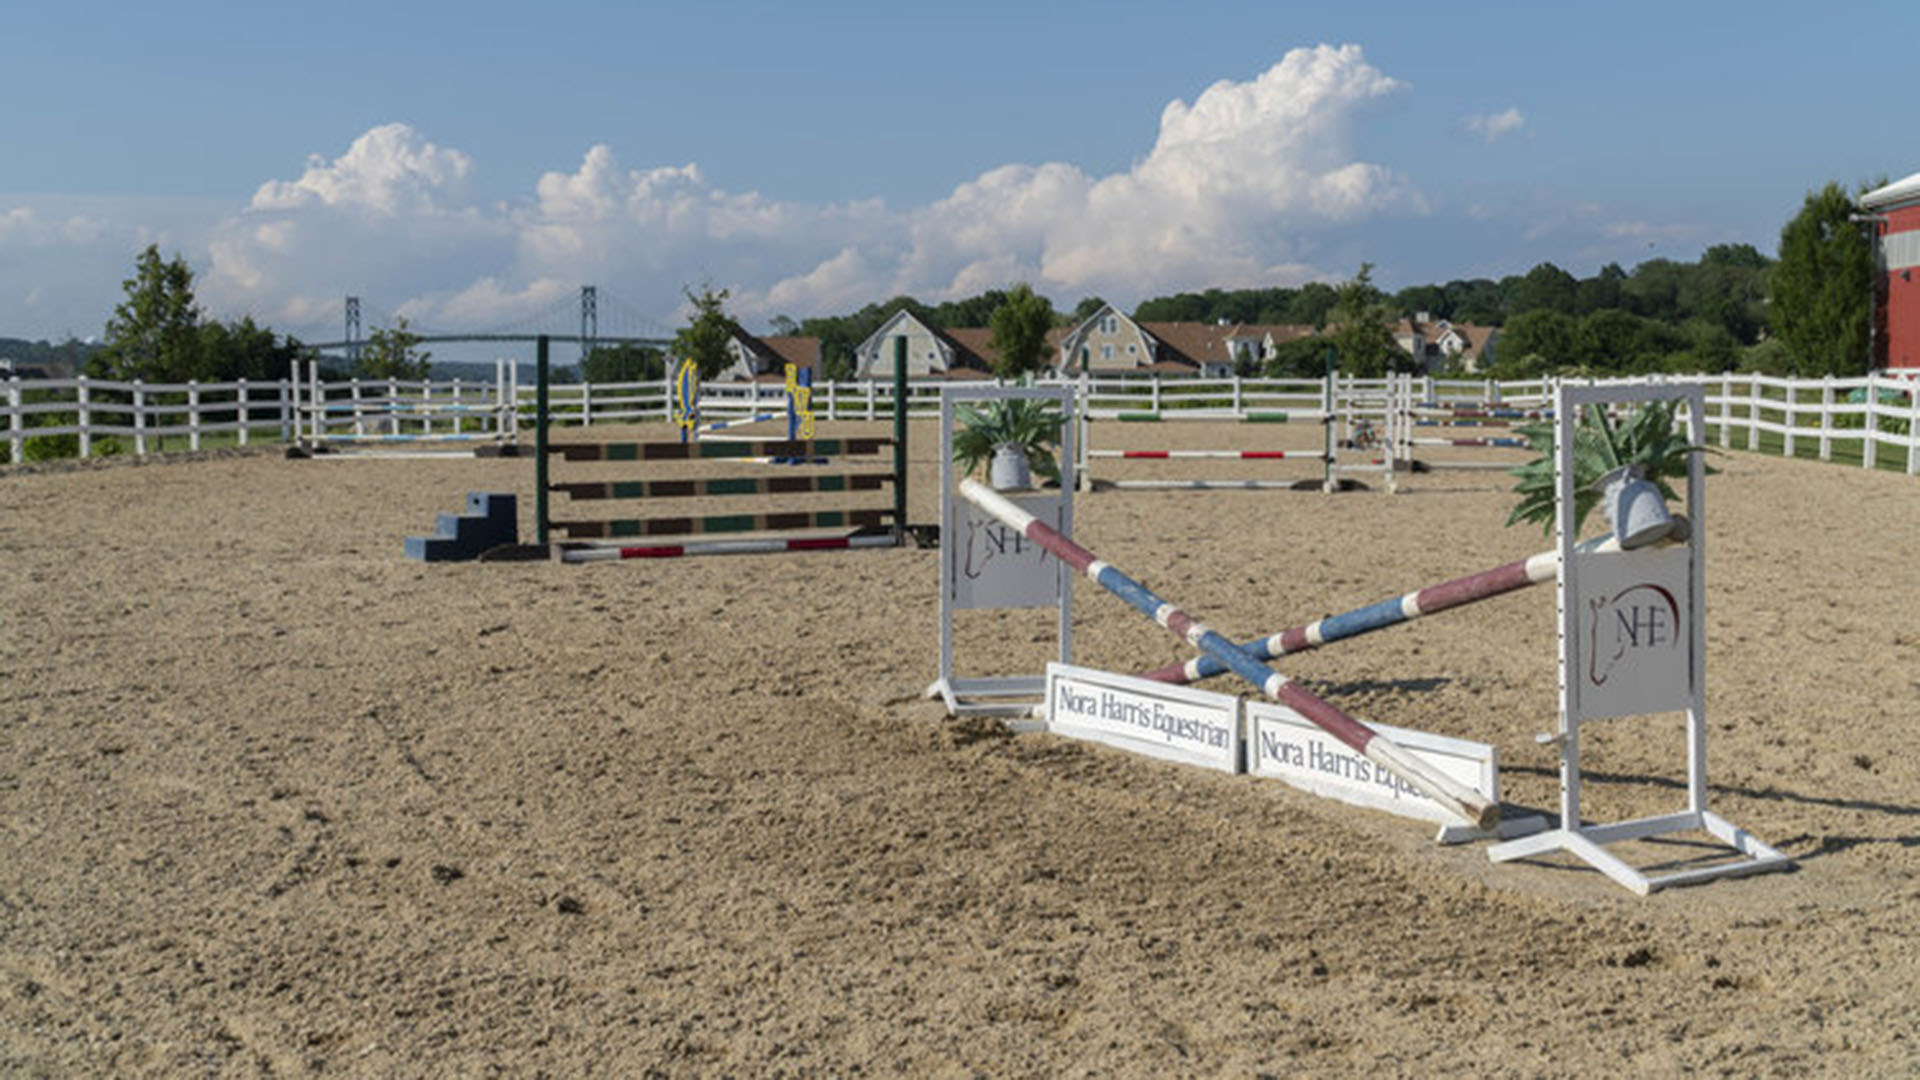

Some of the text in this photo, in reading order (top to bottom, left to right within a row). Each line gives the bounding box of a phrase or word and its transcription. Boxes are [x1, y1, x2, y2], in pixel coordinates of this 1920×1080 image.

[1615, 605, 1666, 647] NHE
[1060, 685, 1230, 749] Nora Harris Equestrian
[1261, 731, 1304, 767] Nora
[1308, 740, 1371, 783] Harris
